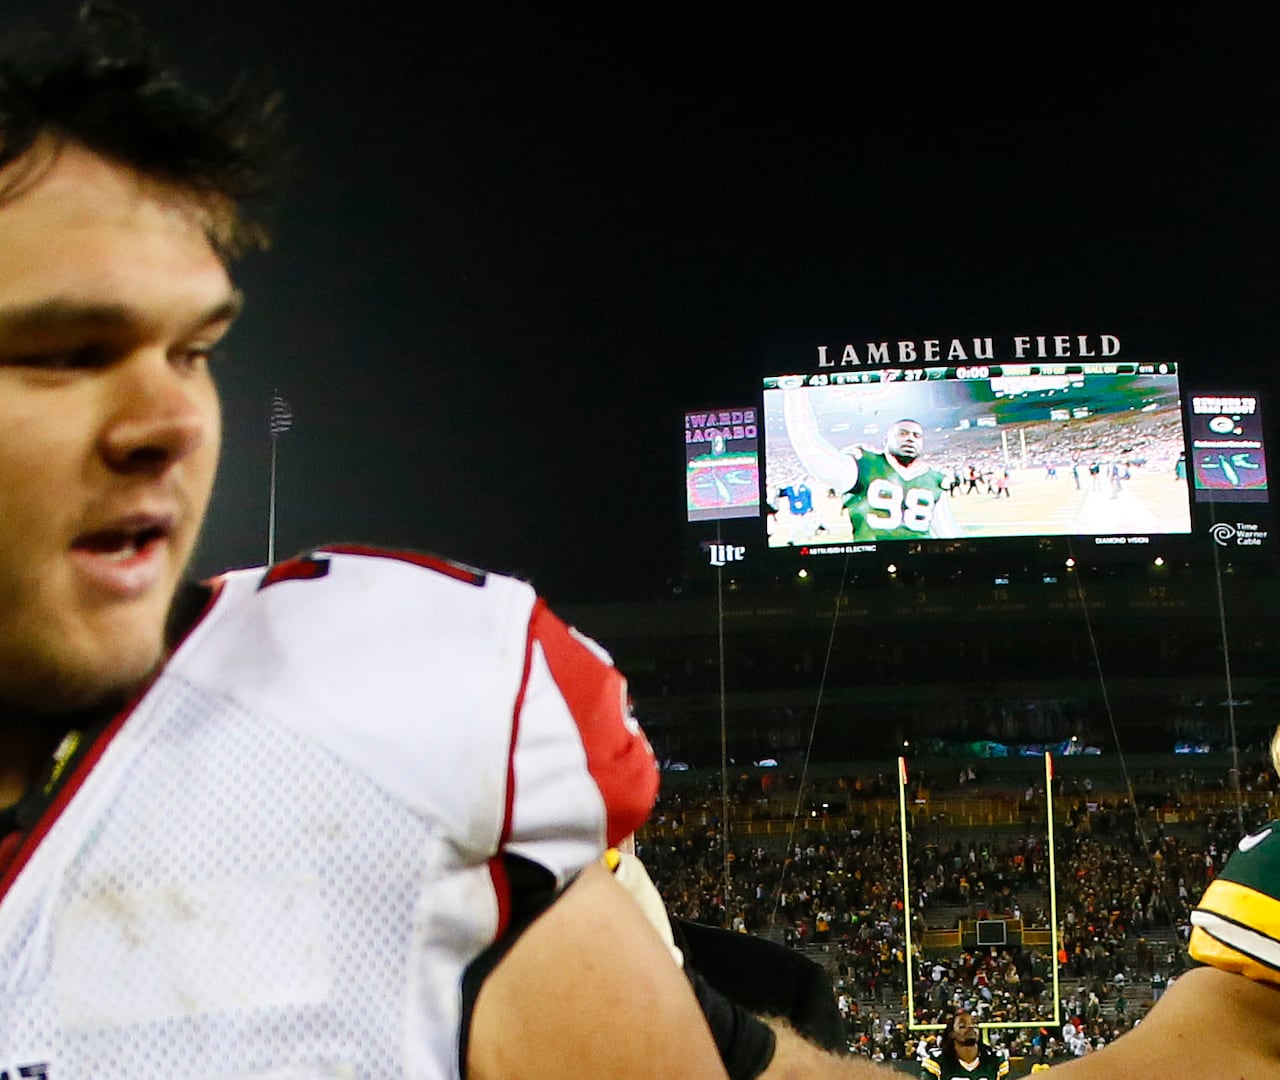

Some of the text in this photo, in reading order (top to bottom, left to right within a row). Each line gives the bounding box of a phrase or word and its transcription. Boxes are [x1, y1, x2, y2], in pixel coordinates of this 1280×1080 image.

[817, 334, 1121, 368] LAMBEAU FIELD
[866, 478, 935, 532] 98
[1236, 522, 1259, 531] Time
[1236, 530, 1268, 539] Warner
[1236, 537, 1262, 546] Cable
[709, 544, 746, 567] Lite
